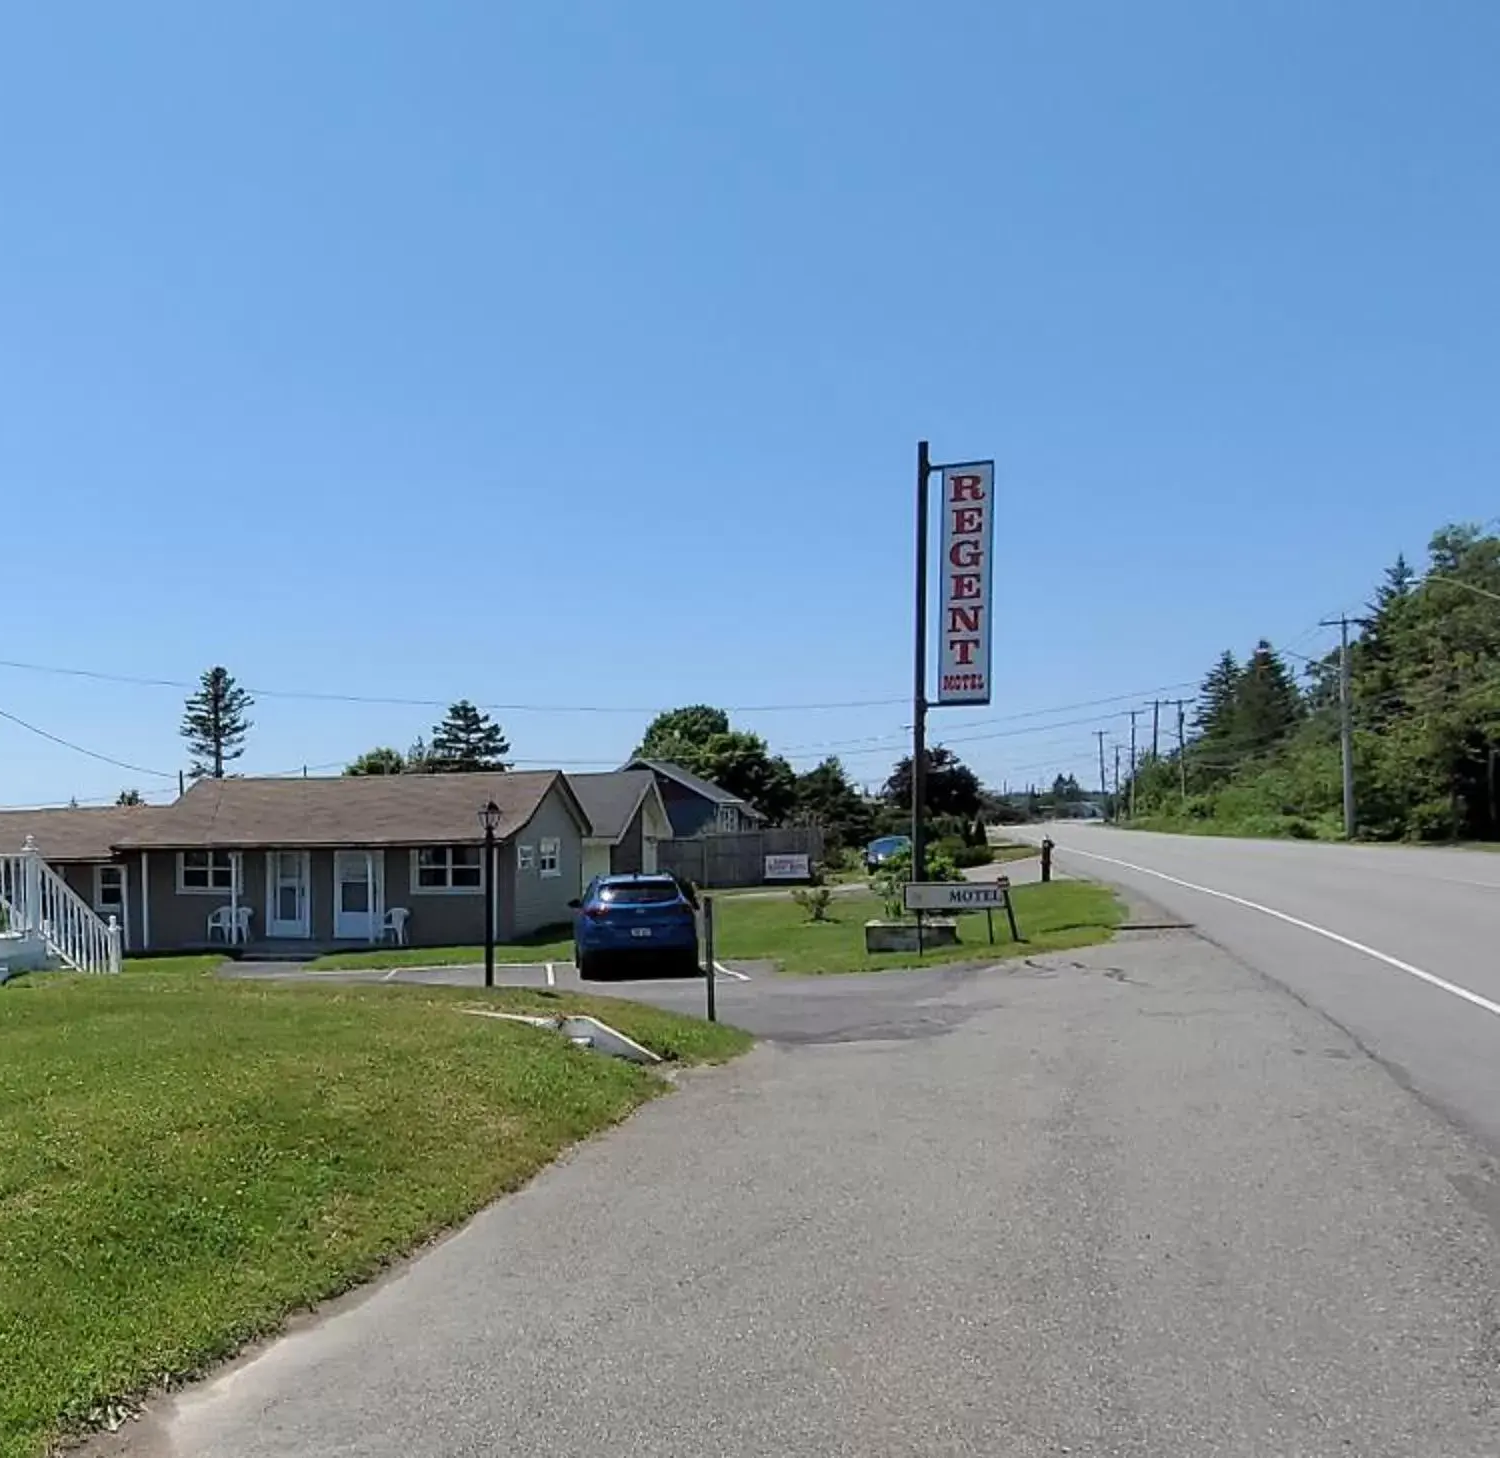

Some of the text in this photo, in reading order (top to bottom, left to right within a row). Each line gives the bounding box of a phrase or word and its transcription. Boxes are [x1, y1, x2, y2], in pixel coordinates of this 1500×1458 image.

[947, 475, 986, 665] REGENT
[942, 674, 985, 691] MOTEL
[949, 888, 1003, 903] MOTEL
